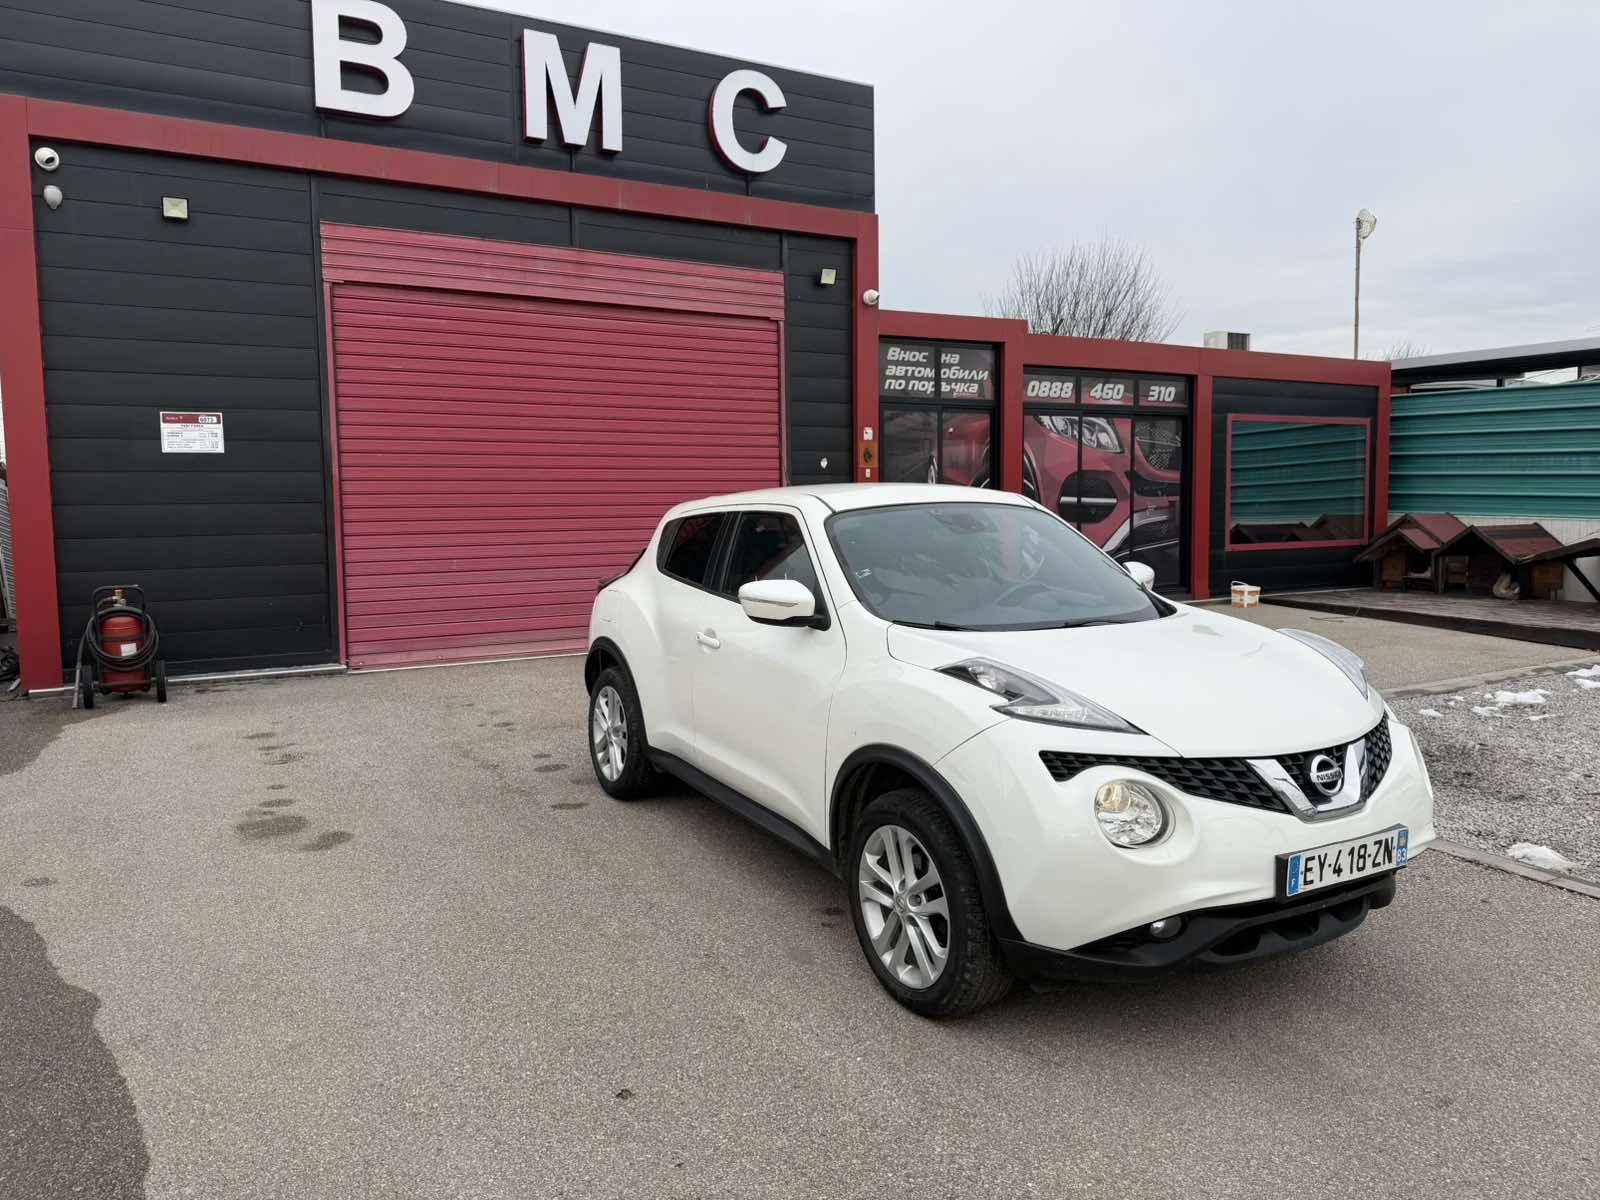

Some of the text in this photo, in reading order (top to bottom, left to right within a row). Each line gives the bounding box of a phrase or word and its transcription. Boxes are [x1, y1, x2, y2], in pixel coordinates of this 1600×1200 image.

[887, 347, 960, 364] Внос на
[884, 379, 906, 390] по
[1026, 380, 1176, 402] 0888 460 310
